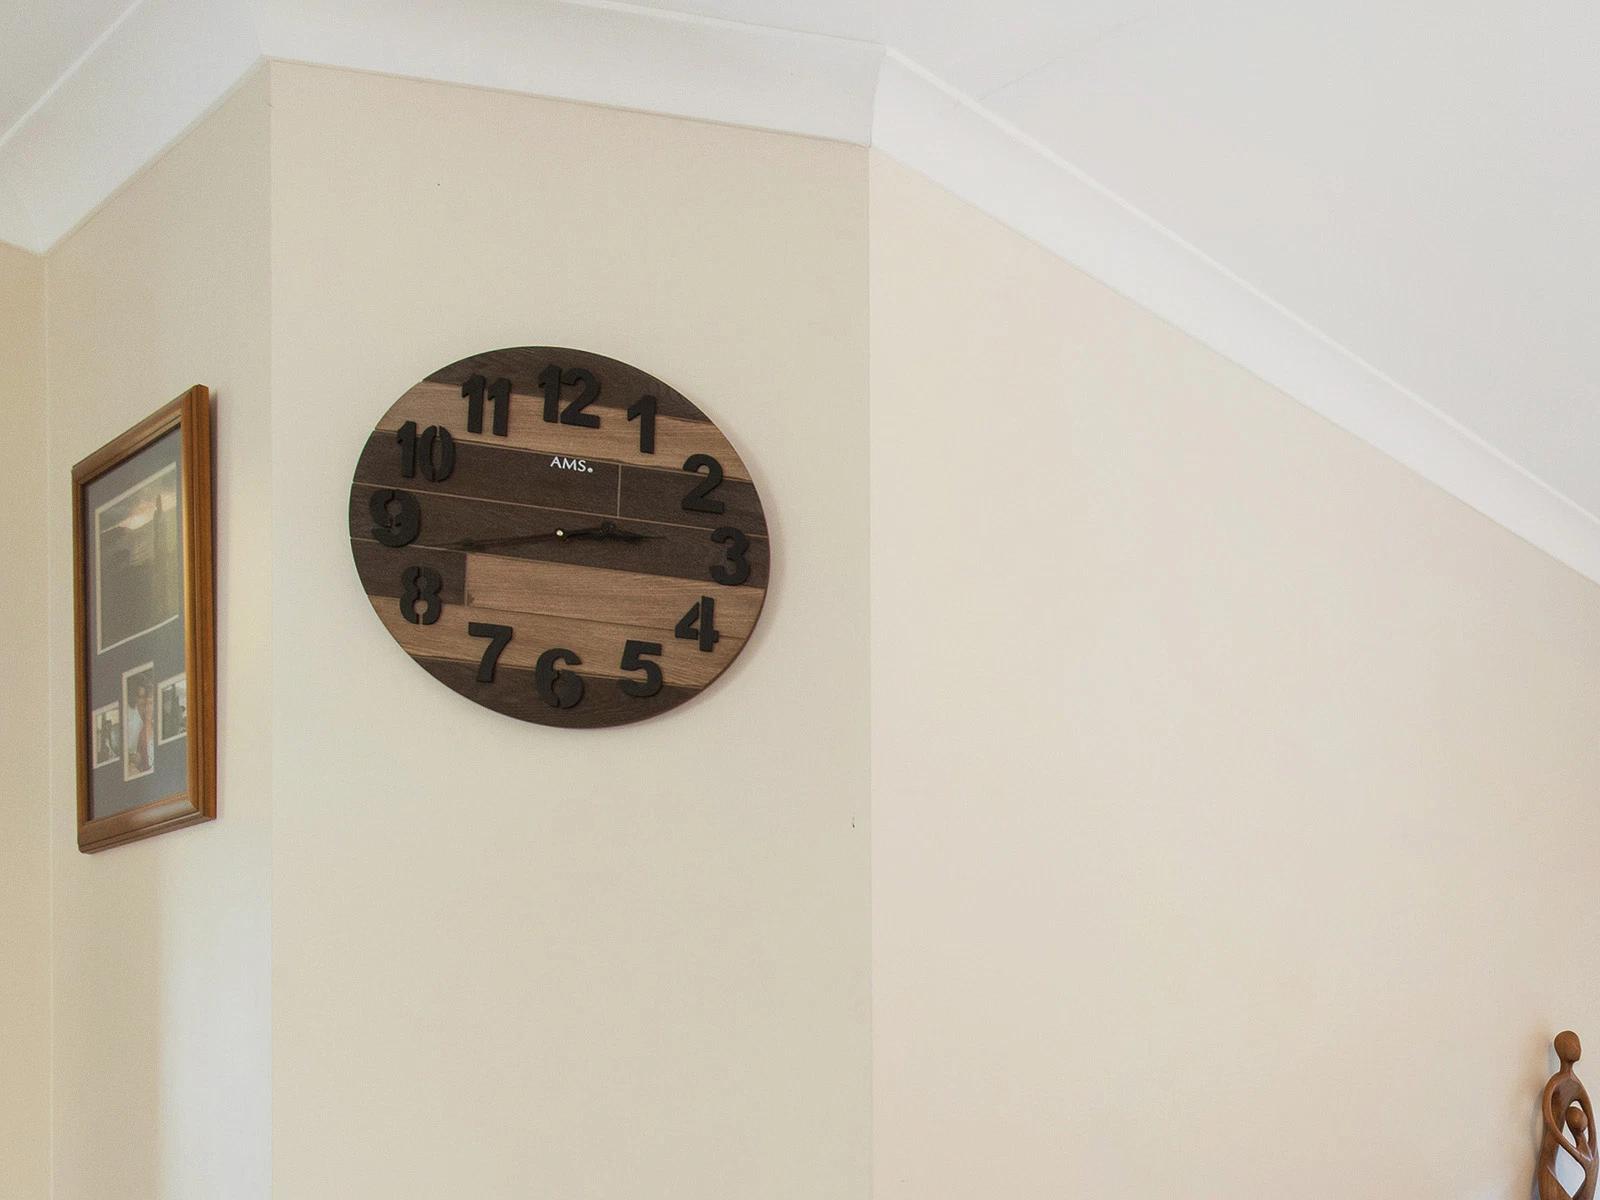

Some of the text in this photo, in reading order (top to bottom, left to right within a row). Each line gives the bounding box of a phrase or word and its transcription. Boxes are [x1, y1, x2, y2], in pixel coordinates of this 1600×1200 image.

[461, 374, 512, 437] 11
[538, 364, 601, 428] 12
[627, 394, 657, 454] 1
[397, 420, 455, 483] 10
[681, 453, 724, 515] 2
[369, 488, 421, 547] 9
[709, 526, 751, 586] 3
[400, 566, 443, 625] 8
[674, 596, 720, 652] 4
[467, 621, 513, 683] 7
[534, 648, 584, 709] 6
[618, 639, 663, 698] 5
